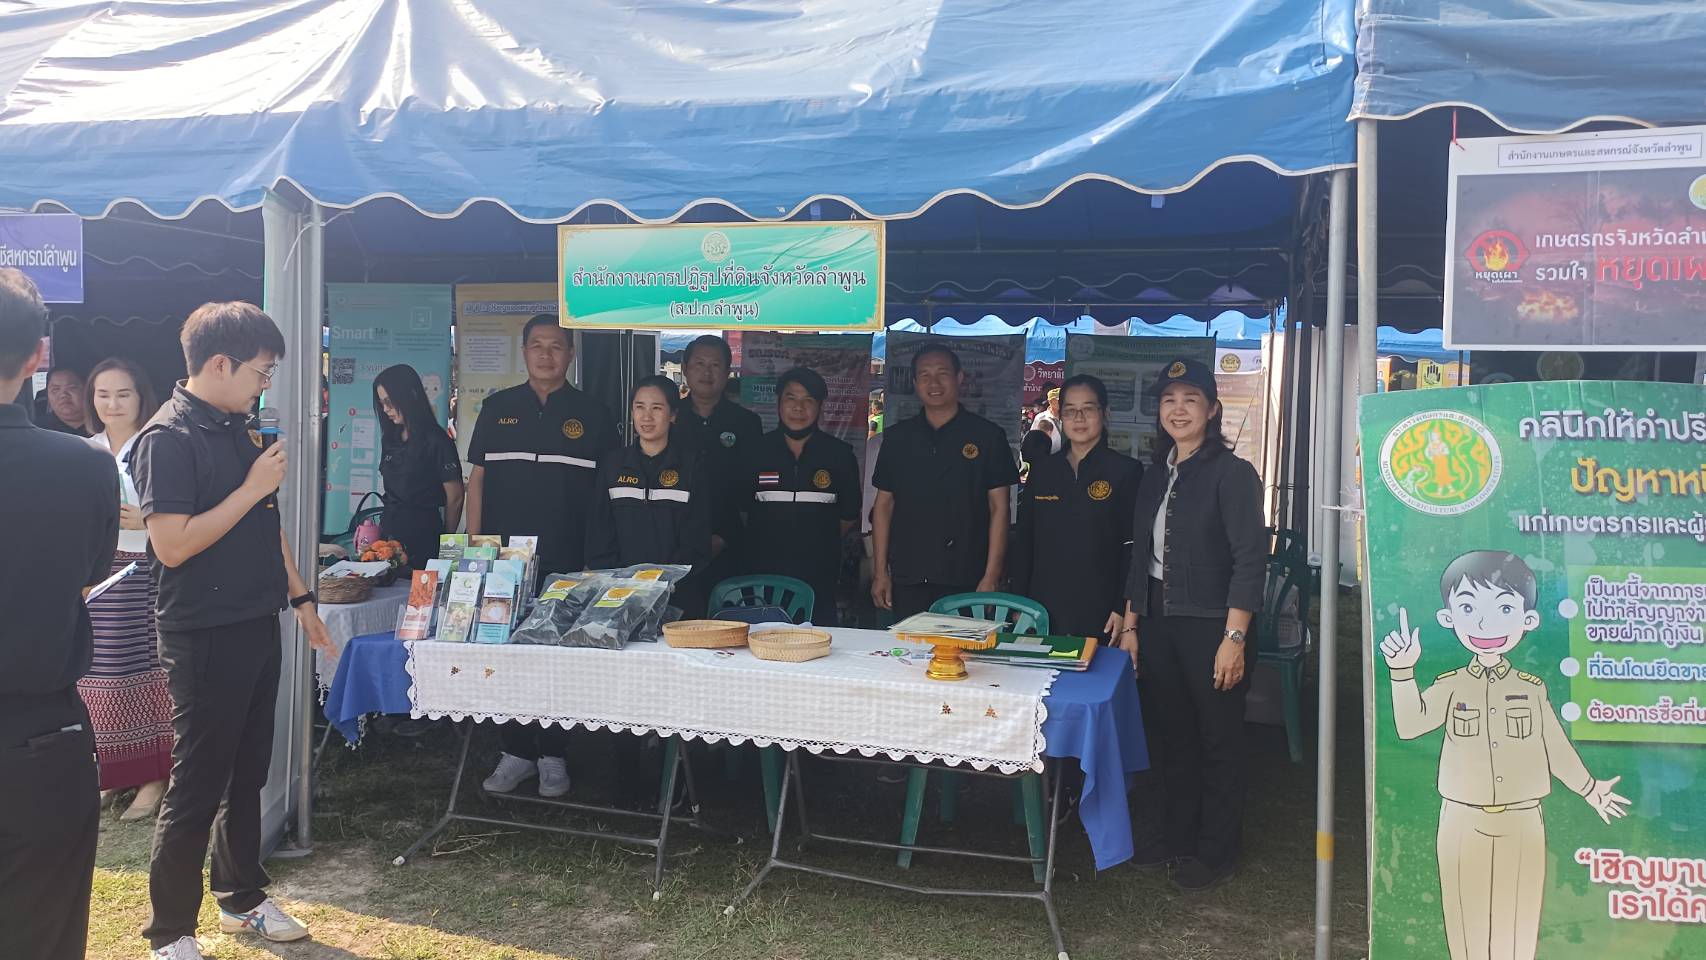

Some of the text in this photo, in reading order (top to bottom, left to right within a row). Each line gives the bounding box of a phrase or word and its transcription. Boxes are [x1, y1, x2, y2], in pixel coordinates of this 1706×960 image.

[1535, 226, 1706, 248] เกษตรกรจังหวัดลำ
[572, 258, 866, 292] สำนักงานการปฏิรูปที่ดินจังหวัดลำพูน
[1475, 271, 1518, 281] หยุดเผา
[1535, 260, 1588, 281] รวมใจ
[669, 300, 760, 320] (ส.ป.ก.ลำพูน)
[332, 325, 374, 339] Smart
[498, 417, 518, 425] ALRO
[617, 475, 639, 484] ALRO
[1588, 623, 1701, 645] ขายฝาก กู้เงิน
